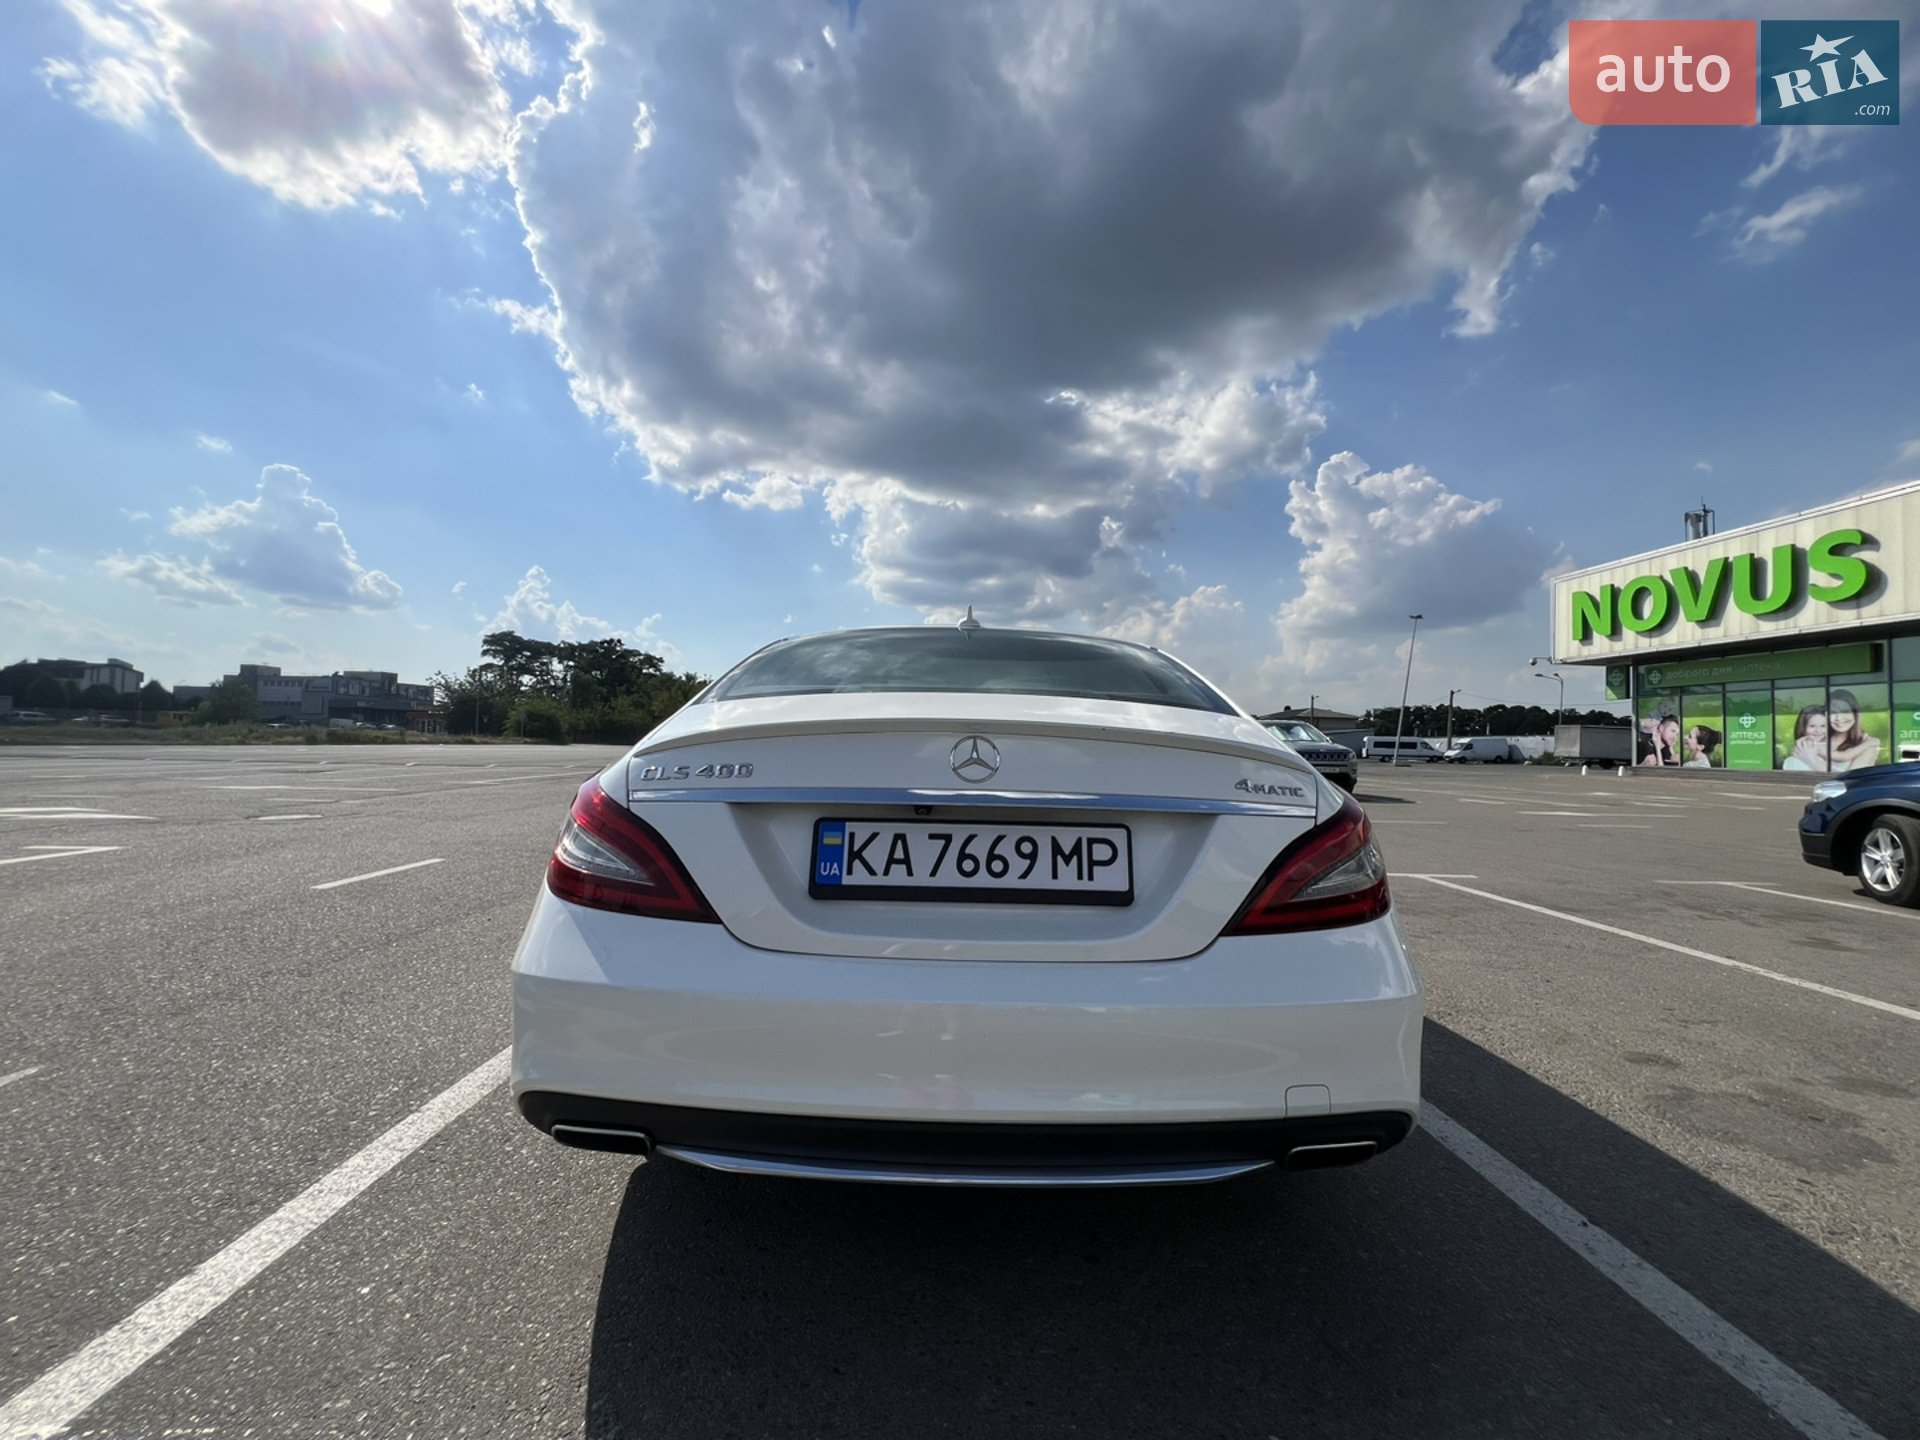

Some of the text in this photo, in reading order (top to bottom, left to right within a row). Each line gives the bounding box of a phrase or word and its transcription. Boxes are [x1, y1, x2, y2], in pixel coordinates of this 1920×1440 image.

[1571, 528, 1870, 641] NOVUS
[640, 763, 754, 781] CLS 400
[1234, 778, 1305, 797] 4MATIC
[846, 831, 1119, 882] KA 7669 MP
[820, 861, 840, 876] UA
